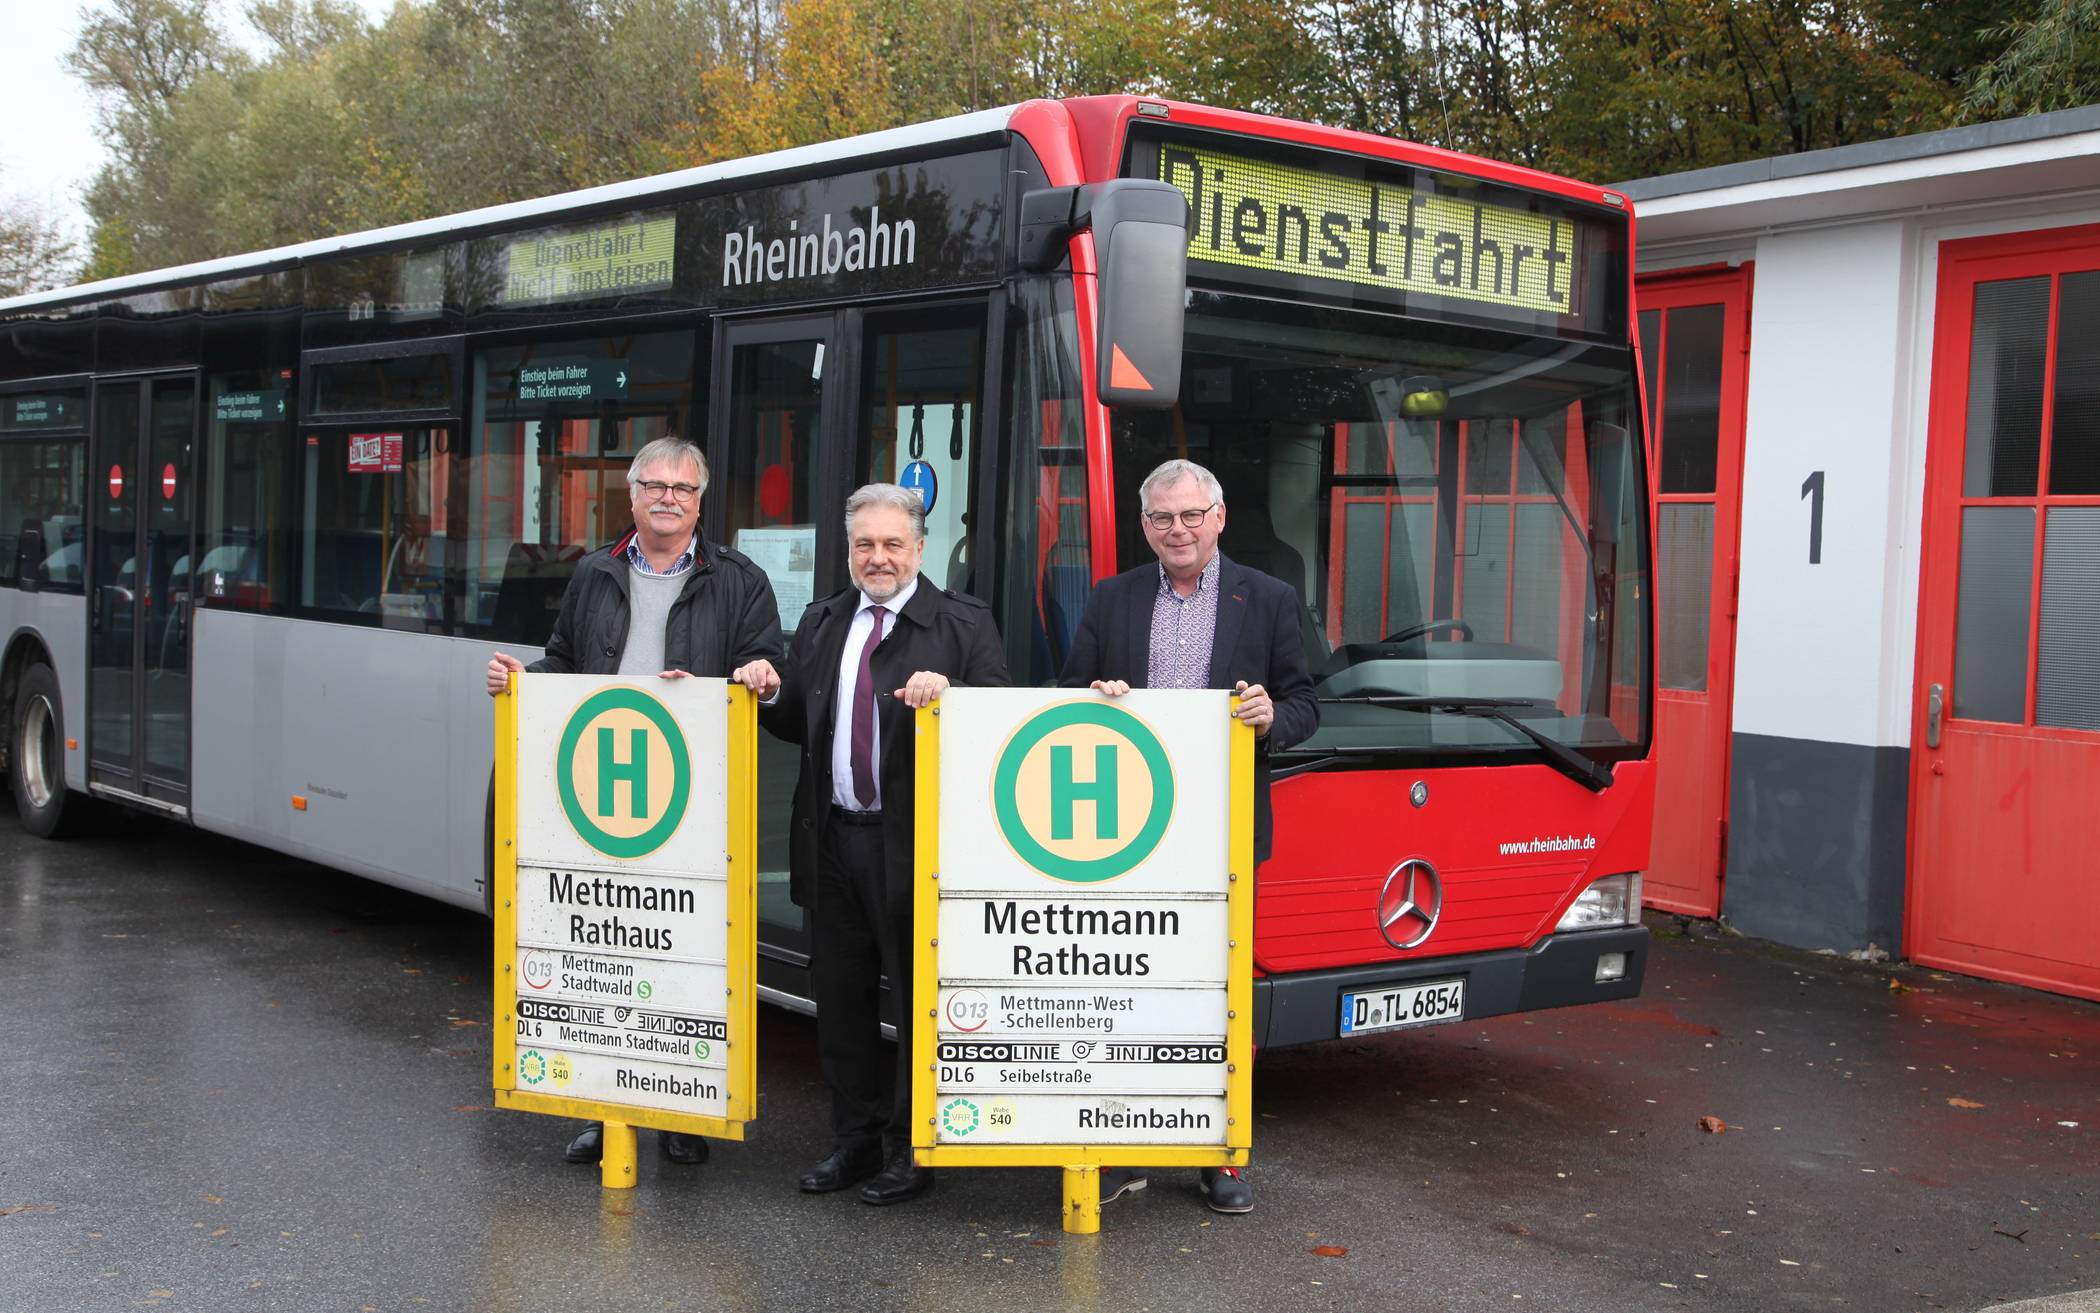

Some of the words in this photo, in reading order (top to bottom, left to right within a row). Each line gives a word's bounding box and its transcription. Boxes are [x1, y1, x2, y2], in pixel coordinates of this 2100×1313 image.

[1163, 151, 1566, 304] Dienstfahrt
[722, 205, 916, 287] Rheinbahn
[520, 369, 546, 384] Einstieg
[548, 367, 565, 381] beim
[566, 365, 588, 379] Fahrer
[520, 386, 536, 399] Bitte
[537, 384, 557, 398] Ticket
[558, 382, 591, 399] vorzeigen
[1801, 470, 1825, 565] 1
[597, 727, 648, 819] H
[1050, 744, 1118, 841] H
[1499, 833, 1596, 855] www.rheinbahn.de
[549, 872, 694, 914] Mettmann
[984, 901, 1179, 936] Mettmann
[570, 914, 673, 951] Rathaus
[562, 954, 634, 977] Mettmann
[1013, 943, 1150, 976] Rathaus
[562, 973, 632, 996] Stadtwald
[1000, 995, 1134, 1011] Mettmann-West
[1354, 997, 1369, 1026] D
[1383, 993, 1408, 1022] TL
[1412, 986, 1459, 1019] 6854
[1000, 1013, 1114, 1032] -Schellenberg
[559, 1026, 622, 1048] Mettmann
[626, 1034, 690, 1055] Stadtwald
[552, 1068, 569, 1080] 540
[616, 1069, 717, 1100] Rheinbahn
[941, 1067, 975, 1083] DL6
[1000, 1069, 1092, 1083] Seibelstraße
[951, 1113, 971, 1121] VRR
[990, 1113, 1012, 1125] 540
[1079, 1108, 1210, 1129] Rheinbahn
